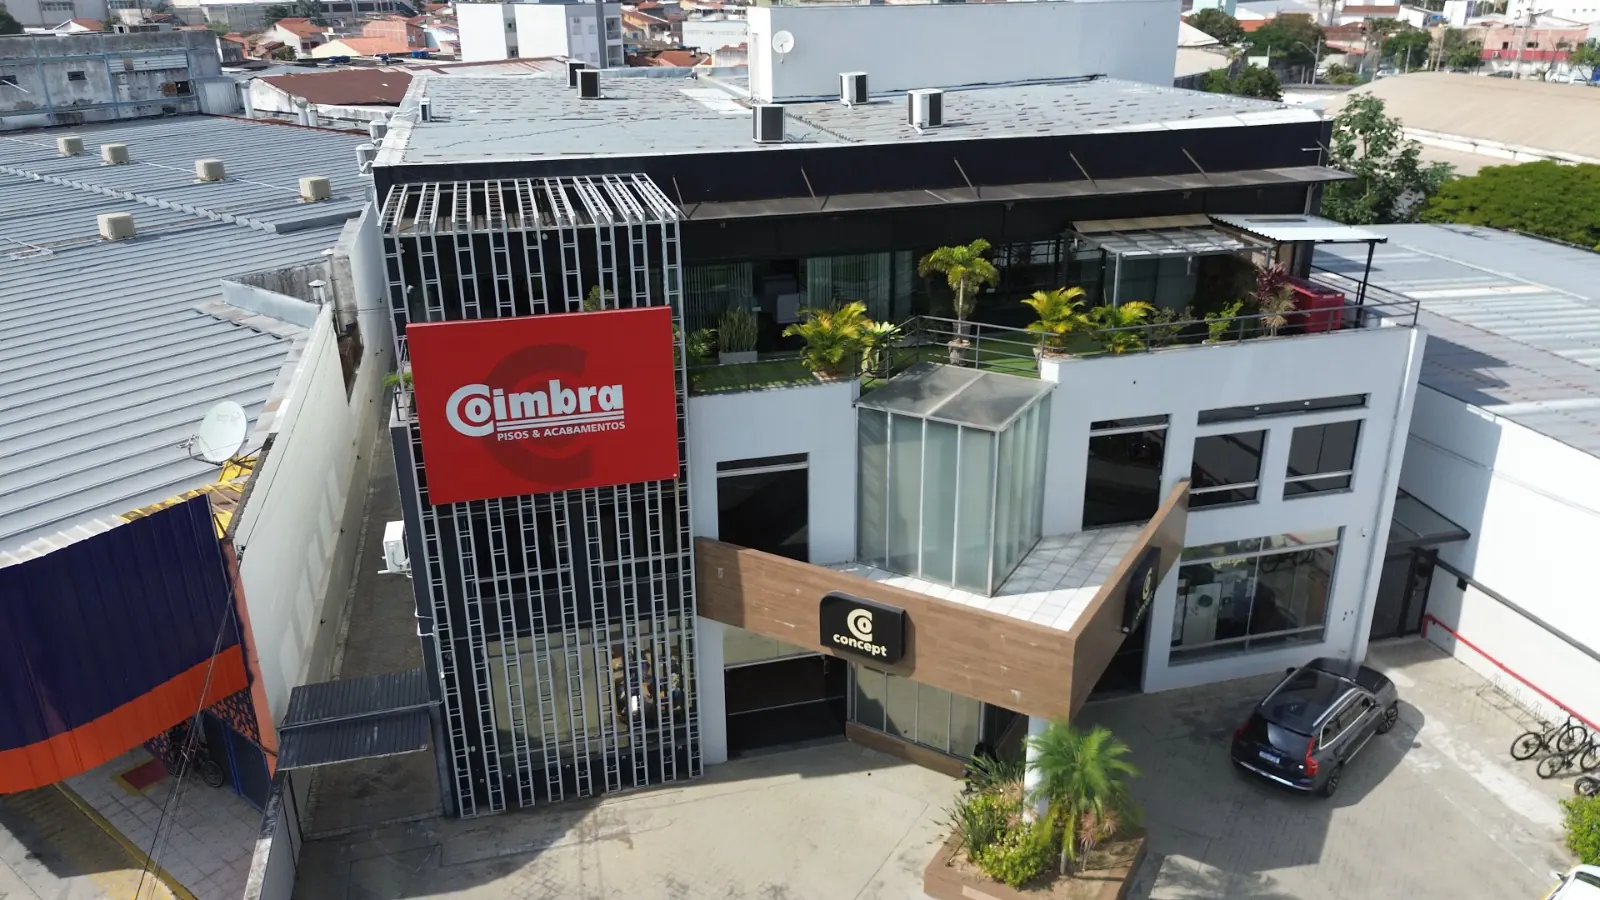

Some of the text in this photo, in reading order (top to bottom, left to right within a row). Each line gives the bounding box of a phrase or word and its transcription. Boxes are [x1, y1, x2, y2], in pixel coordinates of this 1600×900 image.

[446, 379, 624, 437] Coimbra
[497, 421, 626, 441] PISOS & ACABAMENTOS
[833, 633, 887, 657] concept
